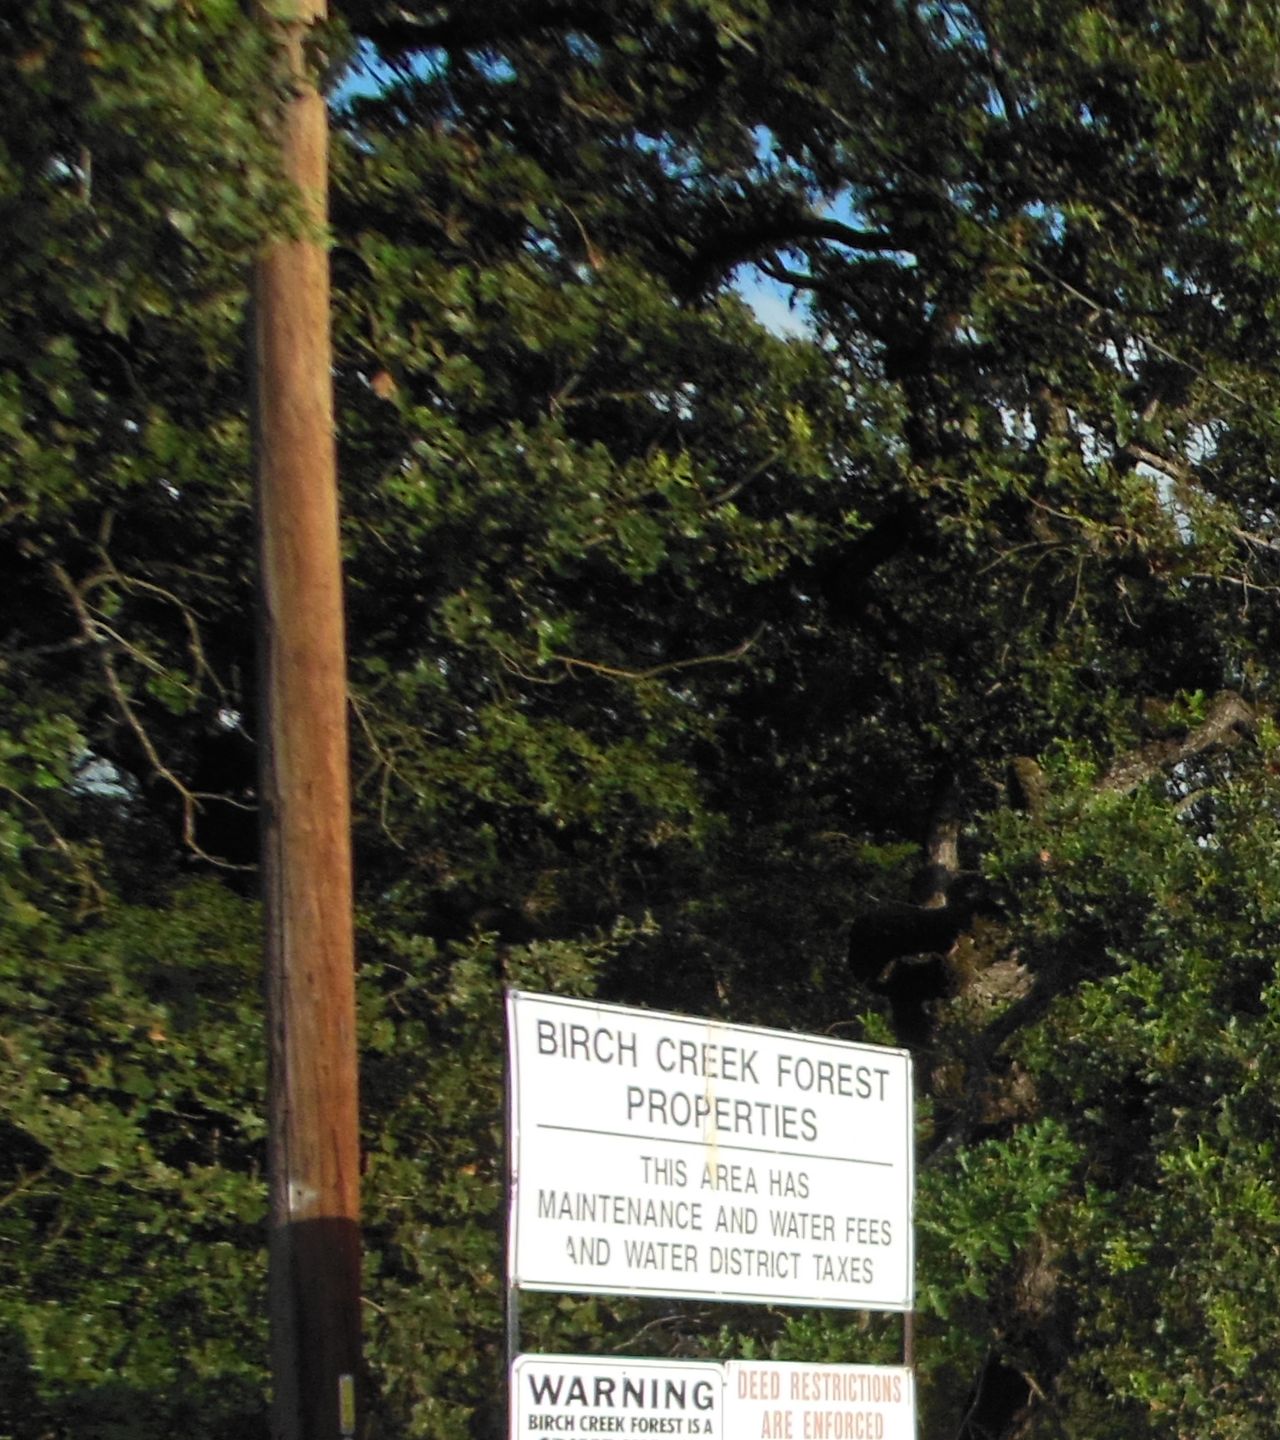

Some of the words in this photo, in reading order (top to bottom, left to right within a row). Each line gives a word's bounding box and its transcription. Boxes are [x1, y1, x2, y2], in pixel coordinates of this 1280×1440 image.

[536, 1018, 637, 1067] BIRCH
[656, 1036, 760, 1085] CREEK
[777, 1053, 890, 1101] FOREST
[626, 1085, 818, 1142] PROPERTIES
[640, 1155, 687, 1188] THIS
[700, 1162, 758, 1194] AREA
[769, 1168, 809, 1199] HAS
[538, 1188, 703, 1231] MAINTENANCE
[715, 1205, 758, 1235] AND
[769, 1209, 835, 1242] WATER
[845, 1217, 892, 1246] FEES
[566, 1235, 611, 1266] AND
[624, 1239, 698, 1272] WATER
[709, 1246, 801, 1279] DISTRICT
[812, 1254, 874, 1284] TAXES
[528, 1374, 715, 1410] WARNING
[737, 1369, 780, 1400] DEED
[790, 1371, 902, 1403] RESTRICTIONS
[528, 1414, 575, 1431] BIRCH
[579, 1415, 625, 1433] CREEK
[631, 1417, 683, 1434] FOREST
[687, 1418, 700, 1434] IS
[703, 1419, 714, 1435] A
[761, 1410, 793, 1439] ARE
[803, 1411, 884, 1440] ENFORCED
